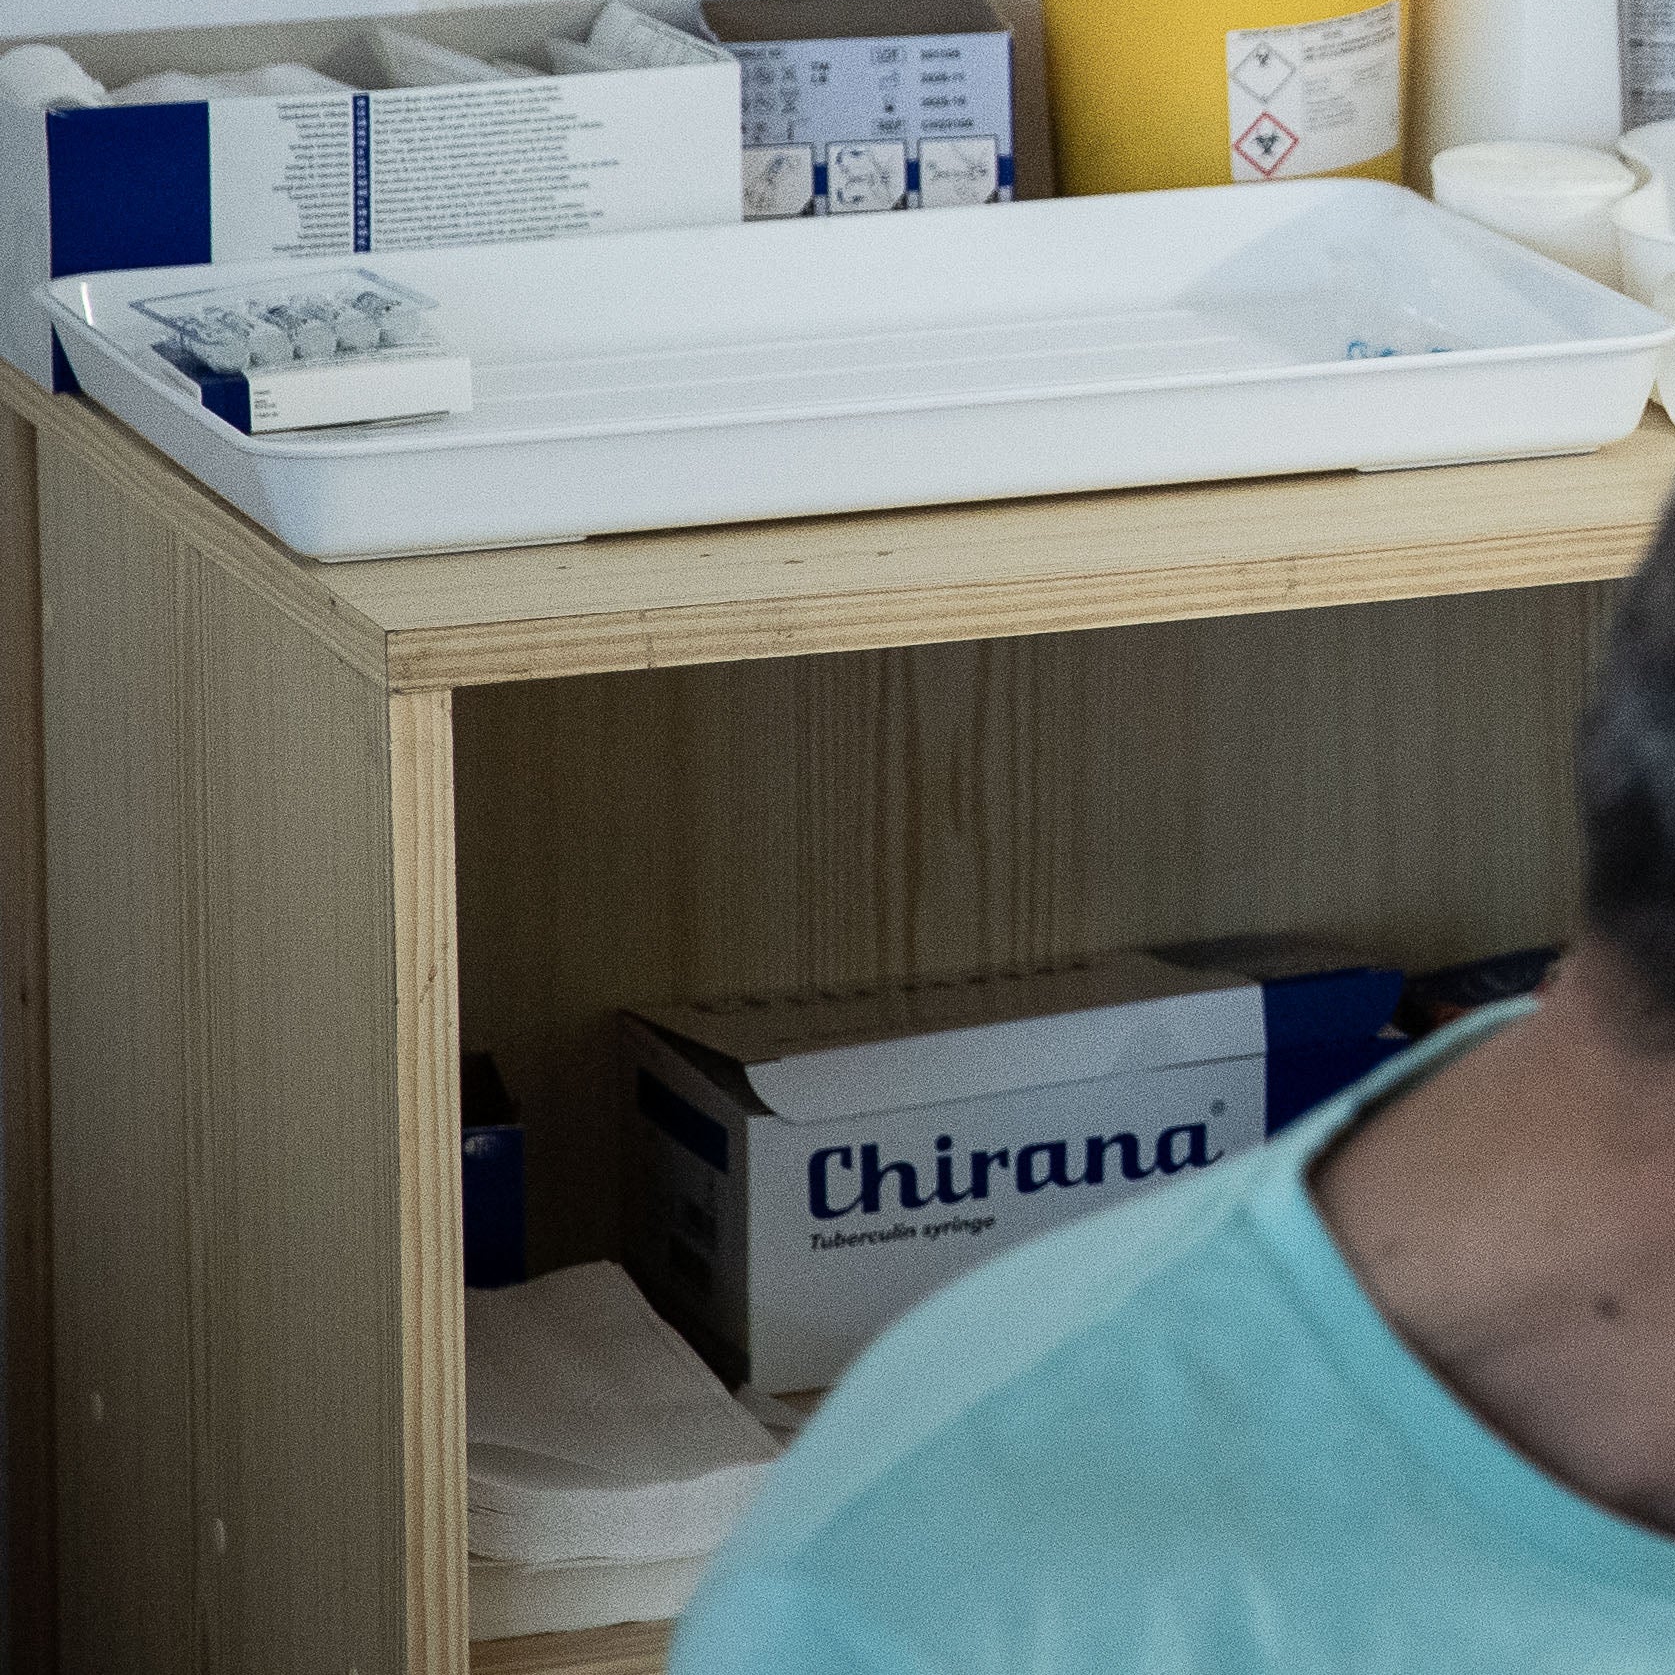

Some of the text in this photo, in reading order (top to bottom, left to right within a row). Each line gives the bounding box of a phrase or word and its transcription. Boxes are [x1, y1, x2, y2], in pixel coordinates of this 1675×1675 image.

[807, 1123, 1225, 1219] Chirana
[809, 1214, 996, 1252] Tuberculin syringe
